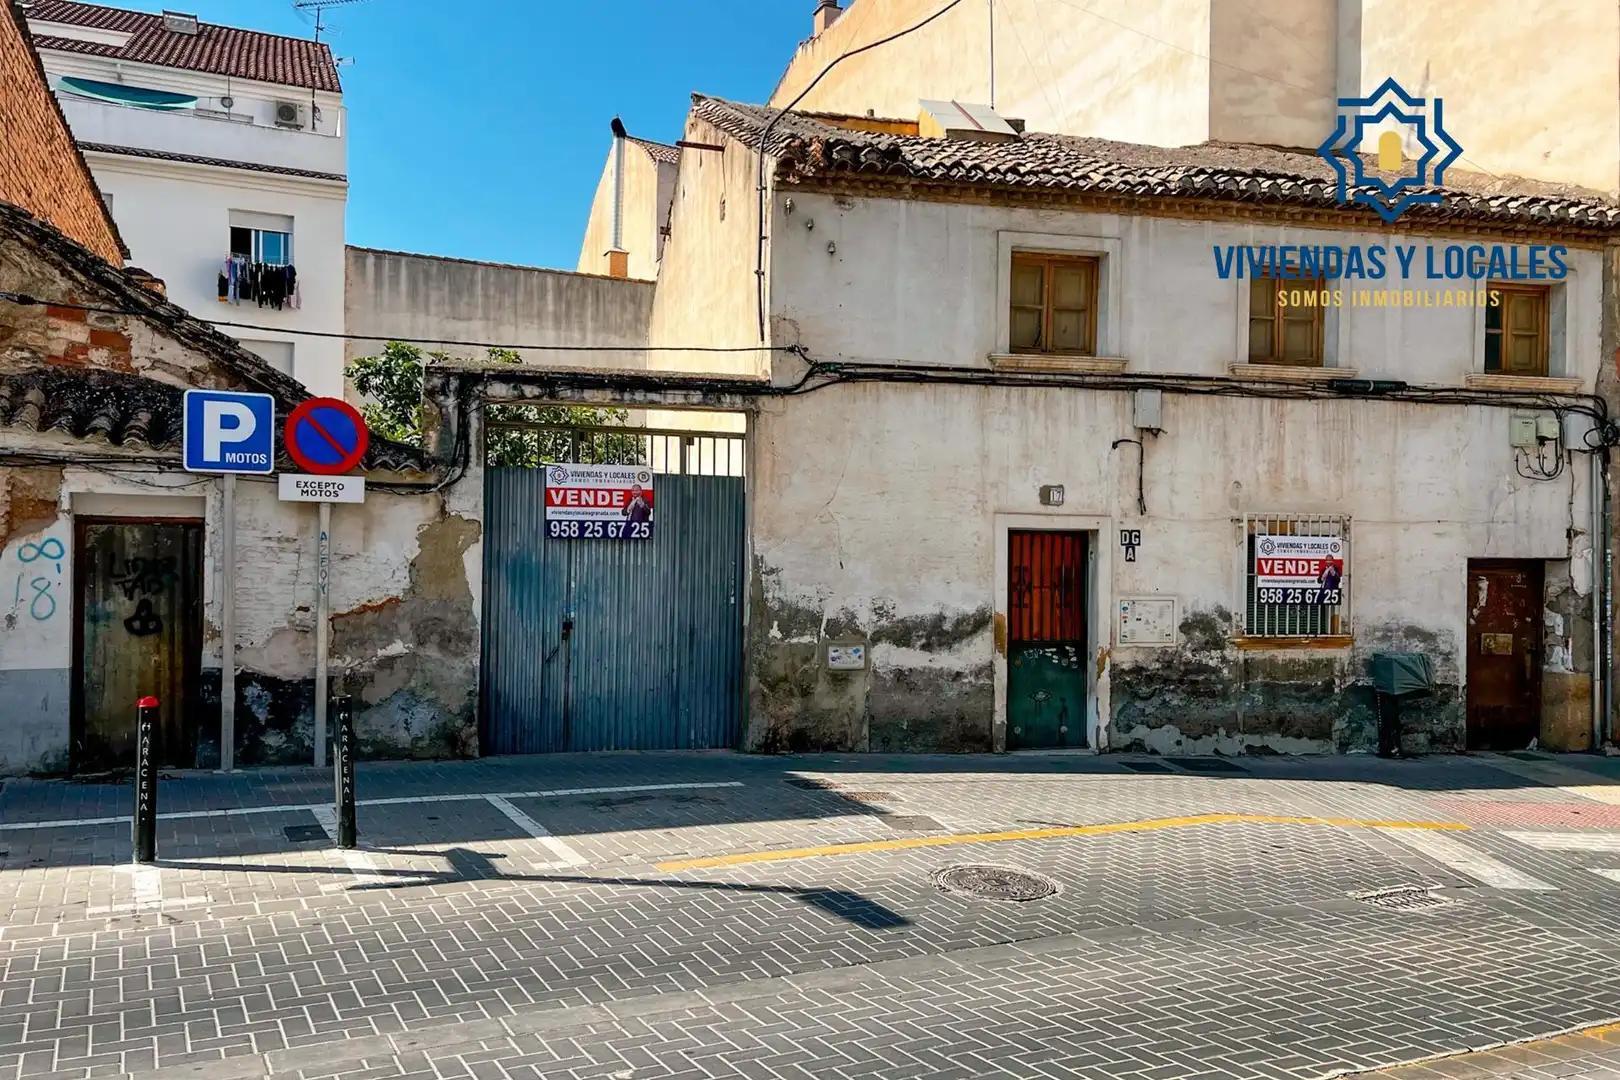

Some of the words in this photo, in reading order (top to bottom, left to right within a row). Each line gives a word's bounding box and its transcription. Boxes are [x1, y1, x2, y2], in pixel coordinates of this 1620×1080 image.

[203, 400, 256, 462] P
[225, 453, 267, 464] MOTOS
[296, 480, 345, 491] EXCEPTO
[300, 489, 339, 498] MOTOS
[549, 489, 625, 506] VENDE
[550, 521, 579, 537] 958
[584, 521, 603, 538] 25
[607, 522, 626, 538] 67
[631, 522, 650, 538] 25
[1121, 531, 1140, 545] DG
[1126, 547, 1135, 560] A
[1260, 560, 1320, 574] VENDE
[1260, 588, 1283, 603] 958
[1286, 589, 1302, 604] 25
[1305, 589, 1320, 604] 67
[1323, 589, 1339, 604] 25
